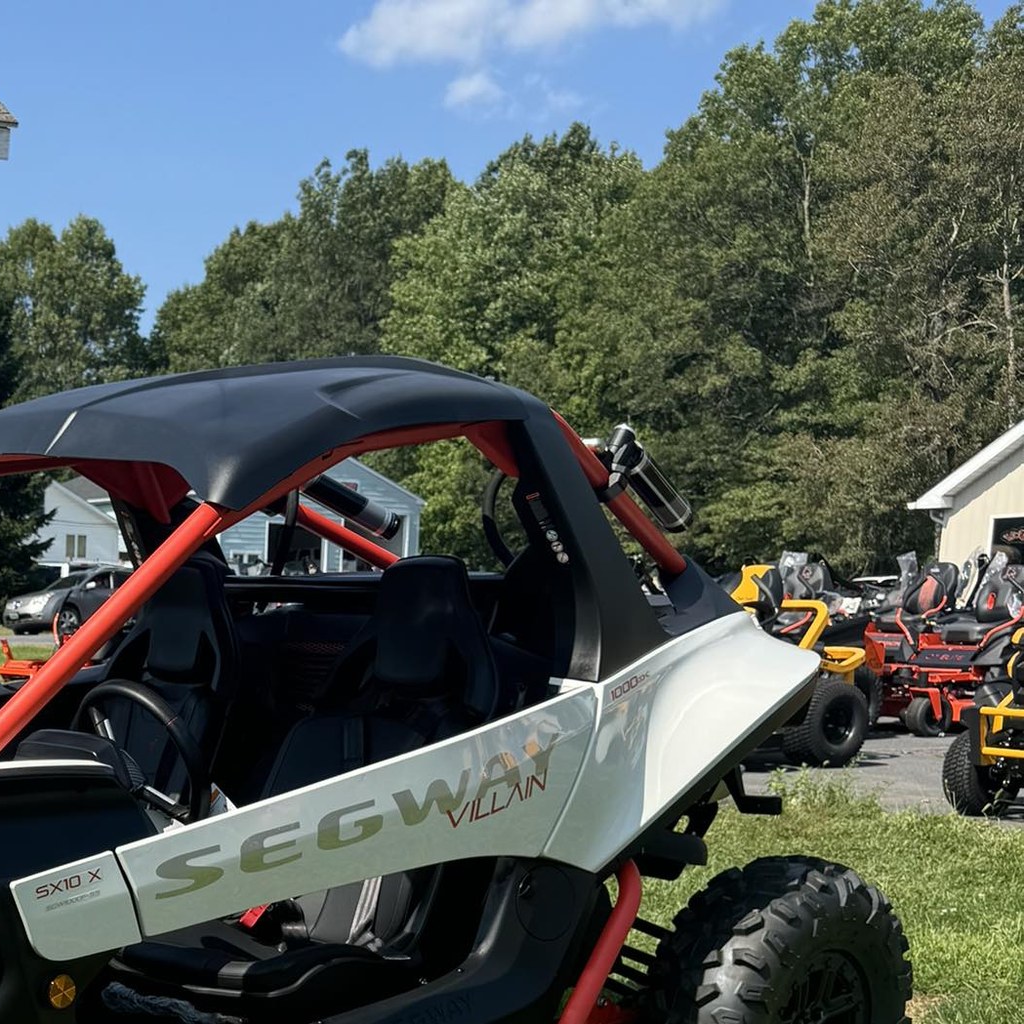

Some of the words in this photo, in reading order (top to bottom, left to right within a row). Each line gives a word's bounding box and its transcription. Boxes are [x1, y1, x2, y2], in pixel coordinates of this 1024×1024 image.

[154, 732, 559, 900] SEGWAY
[446, 768, 548, 829] VILLAIN
[35, 874, 82, 900] SX10
[87, 867, 102, 884] X
